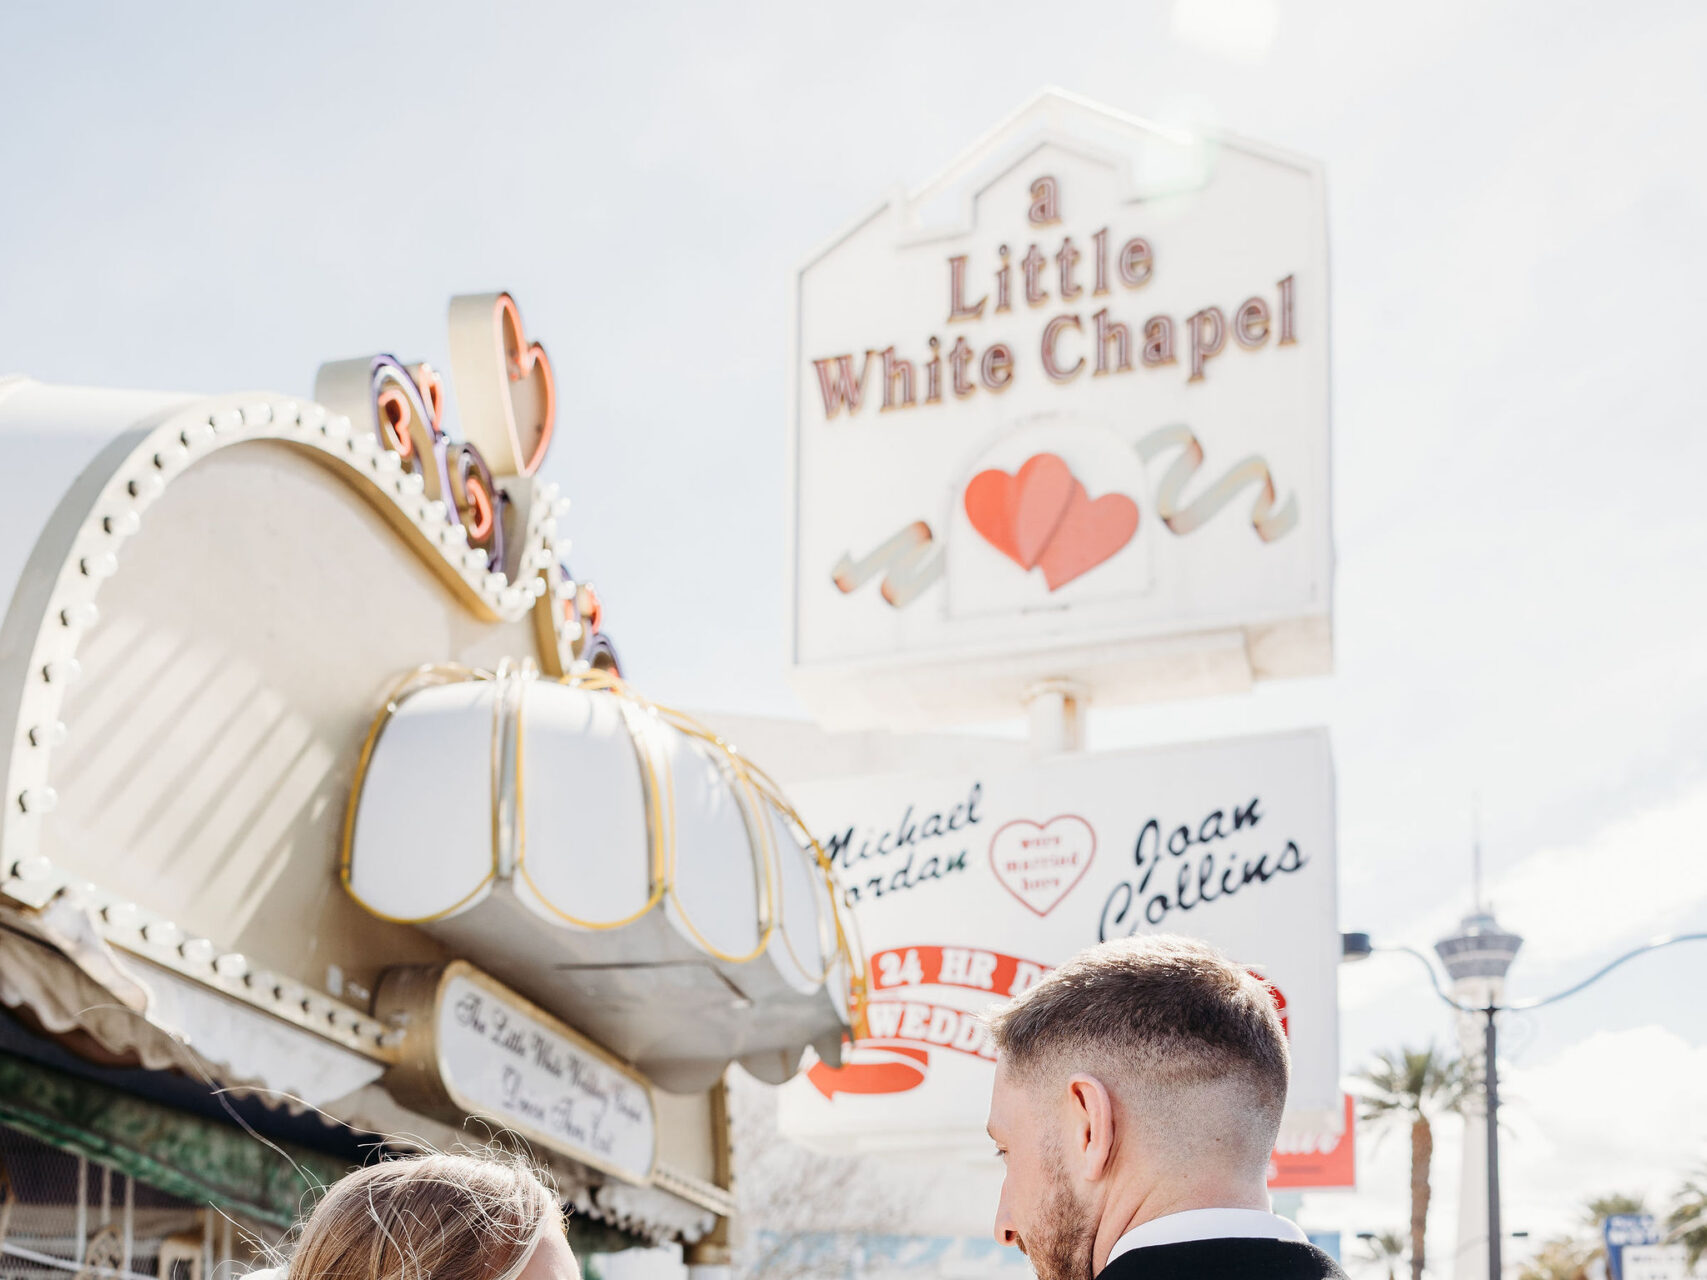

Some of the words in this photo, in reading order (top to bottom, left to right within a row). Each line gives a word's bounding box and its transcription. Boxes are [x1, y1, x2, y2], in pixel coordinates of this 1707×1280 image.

[1028, 175, 1062, 227] a
[946, 227, 1155, 324] Little
[813, 335, 1016, 421] White
[1040, 274, 1299, 385] Chapel
[803, 782, 983, 869] Michael
[1134, 797, 1264, 895] Joan
[842, 850, 968, 909] ordan
[1097, 839, 1310, 943] Collins
[878, 949, 923, 988] 24
[938, 947, 997, 990] HR
